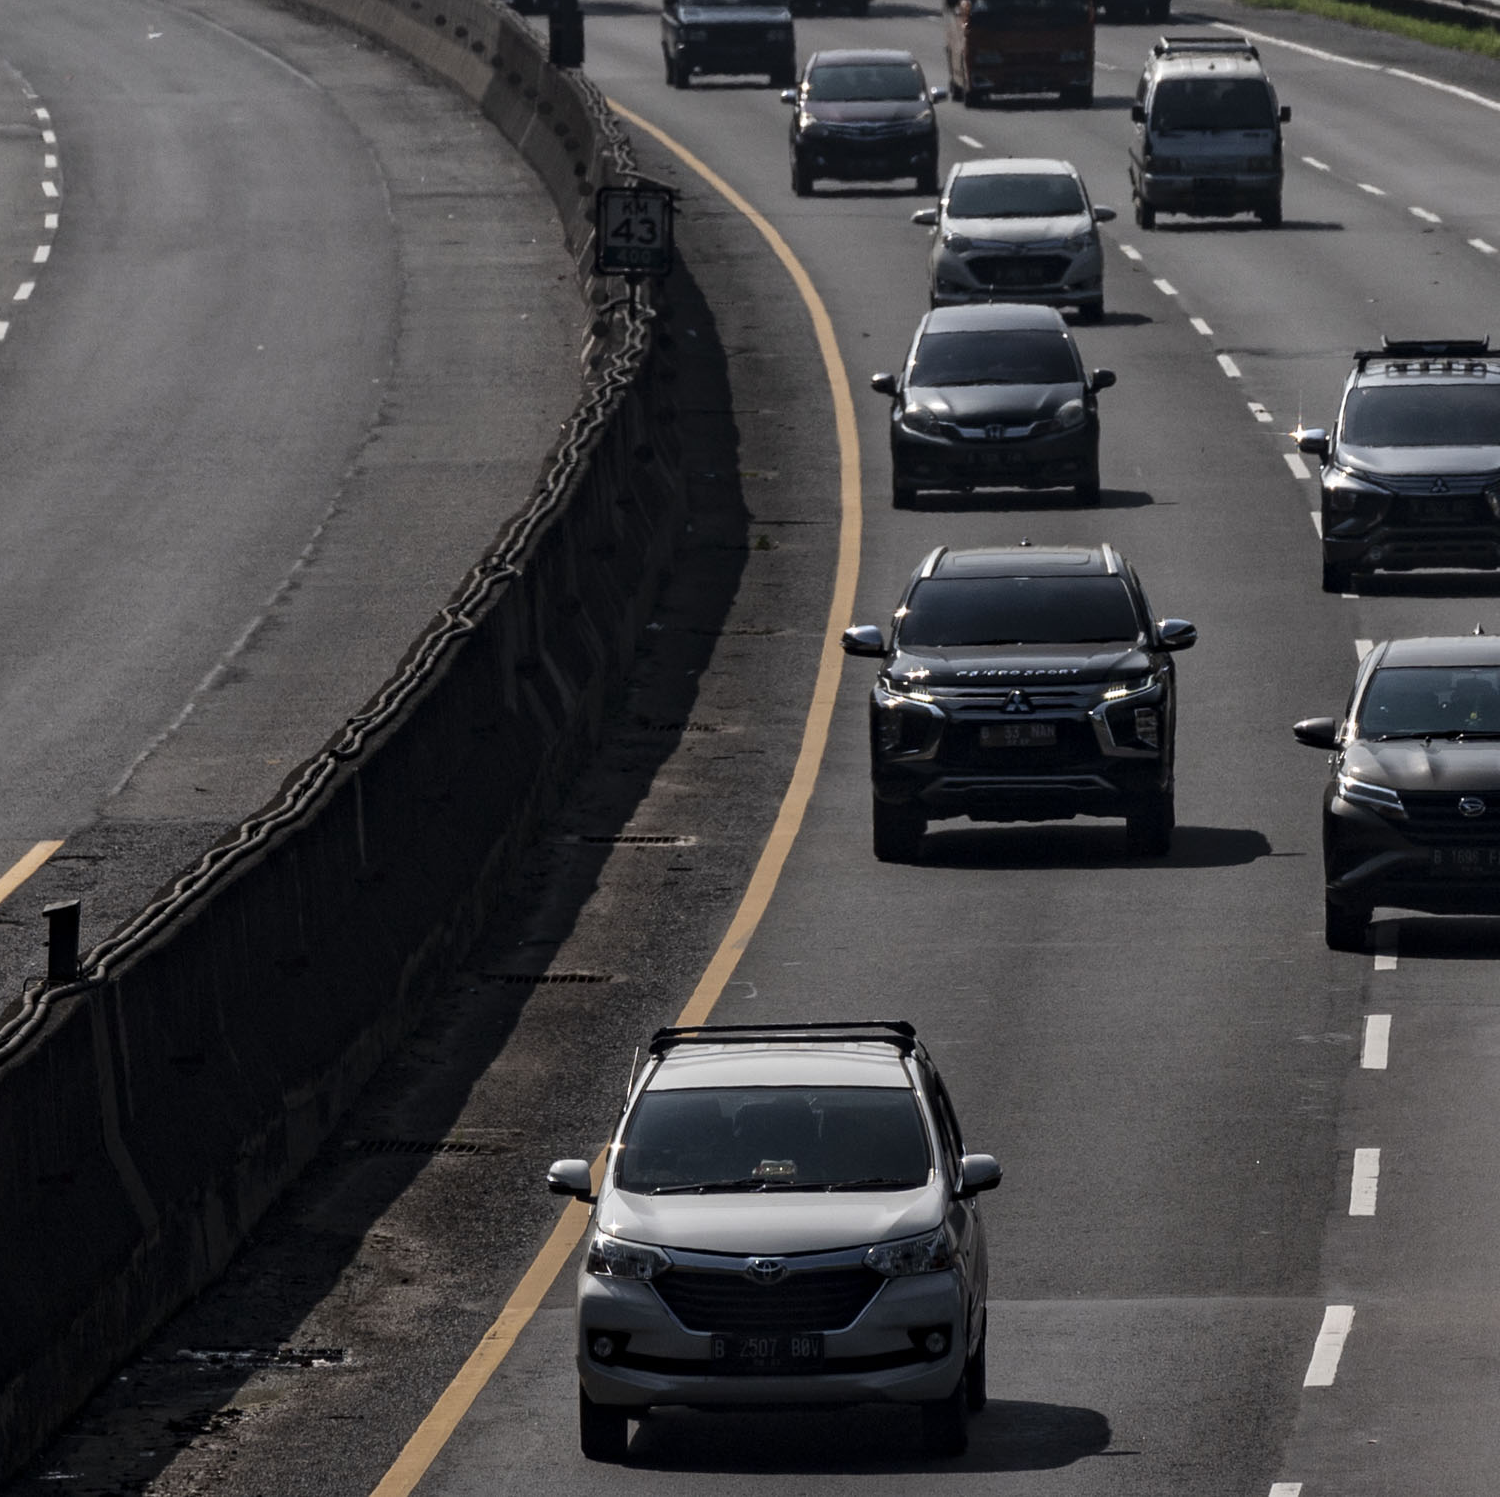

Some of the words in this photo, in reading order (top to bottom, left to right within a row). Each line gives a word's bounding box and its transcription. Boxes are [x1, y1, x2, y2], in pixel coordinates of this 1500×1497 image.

[622, 200, 648, 215] KM
[611, 217, 657, 245] 43
[616, 249, 653, 264] 400
[1433, 848, 1442, 864] B
[714, 1338, 725, 1359] B
[739, 1337, 778, 1358] 2507
